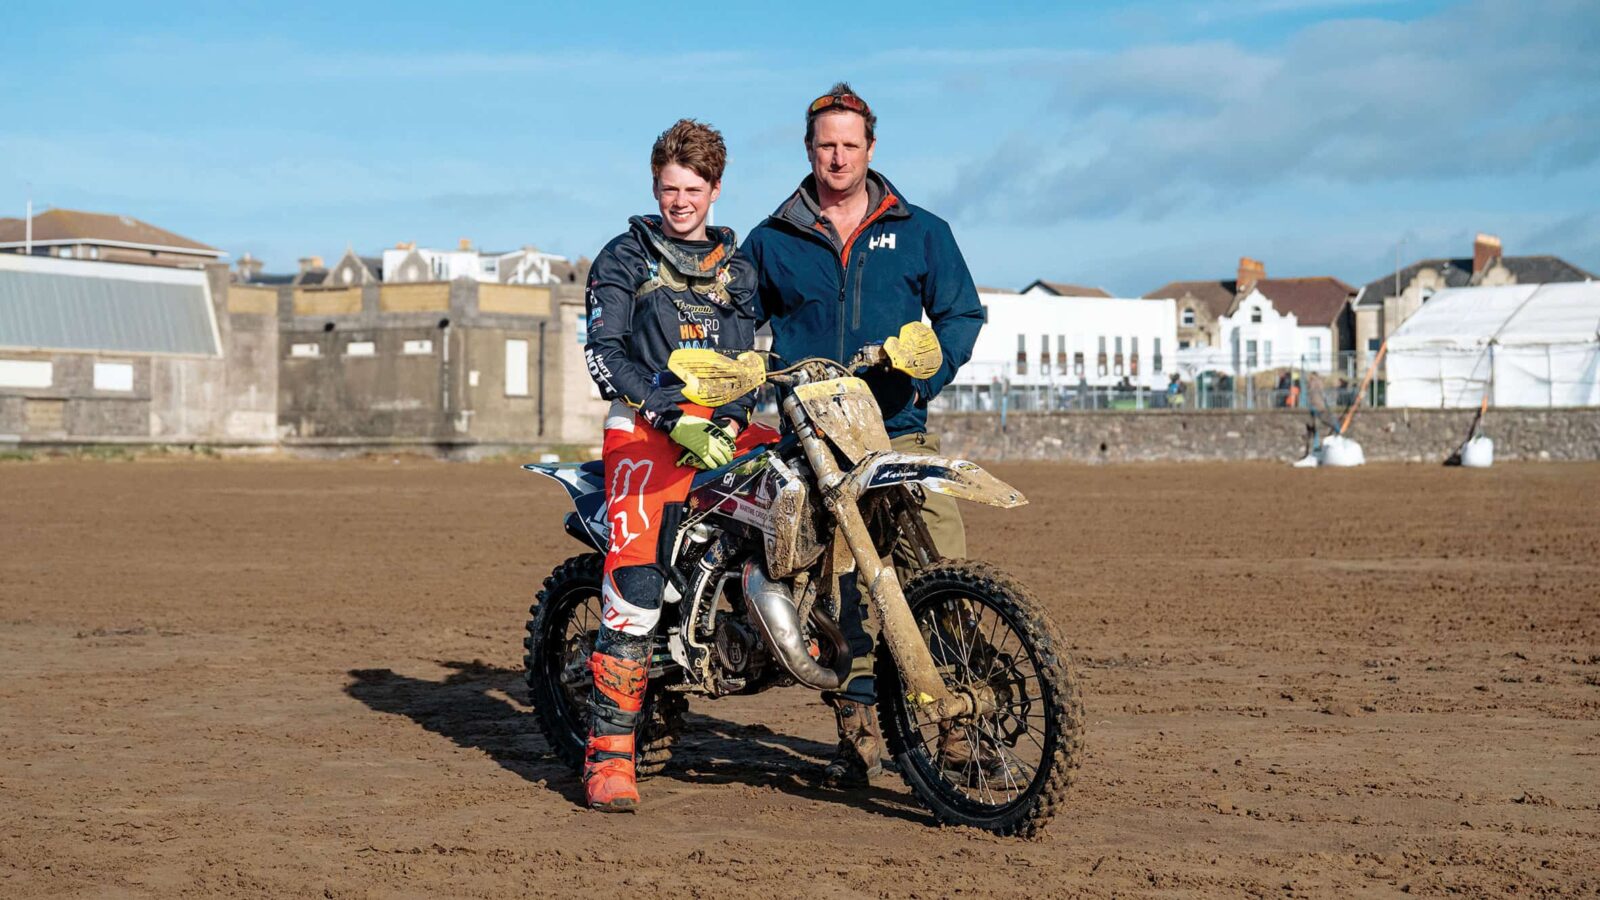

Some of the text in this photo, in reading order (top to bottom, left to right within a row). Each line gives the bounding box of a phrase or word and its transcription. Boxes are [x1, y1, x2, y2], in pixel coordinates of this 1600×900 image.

[585, 348, 618, 393] NOTT
[595, 354, 613, 378] Harry
[603, 593, 633, 632] FOX
